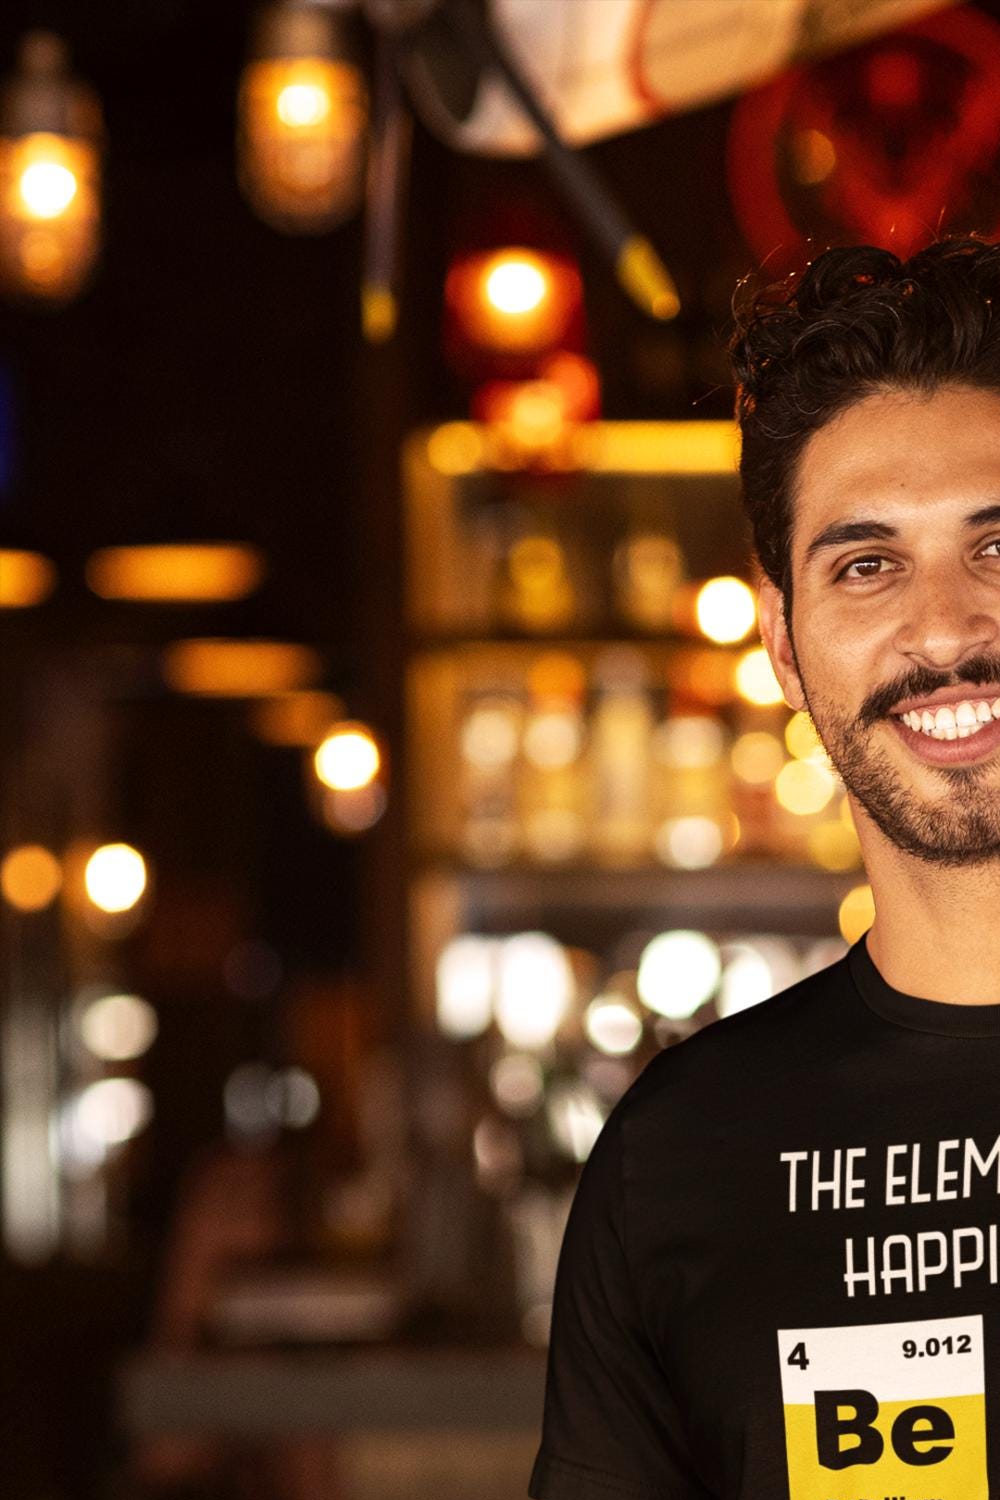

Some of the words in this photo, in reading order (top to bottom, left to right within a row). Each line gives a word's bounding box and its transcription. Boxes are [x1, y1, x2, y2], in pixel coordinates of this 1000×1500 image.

[780, 1147, 867, 1212] THE
[787, 1342, 810, 1371] 4
[902, 1334, 972, 1359] 9.012
[814, 1389, 955, 1471] Be
